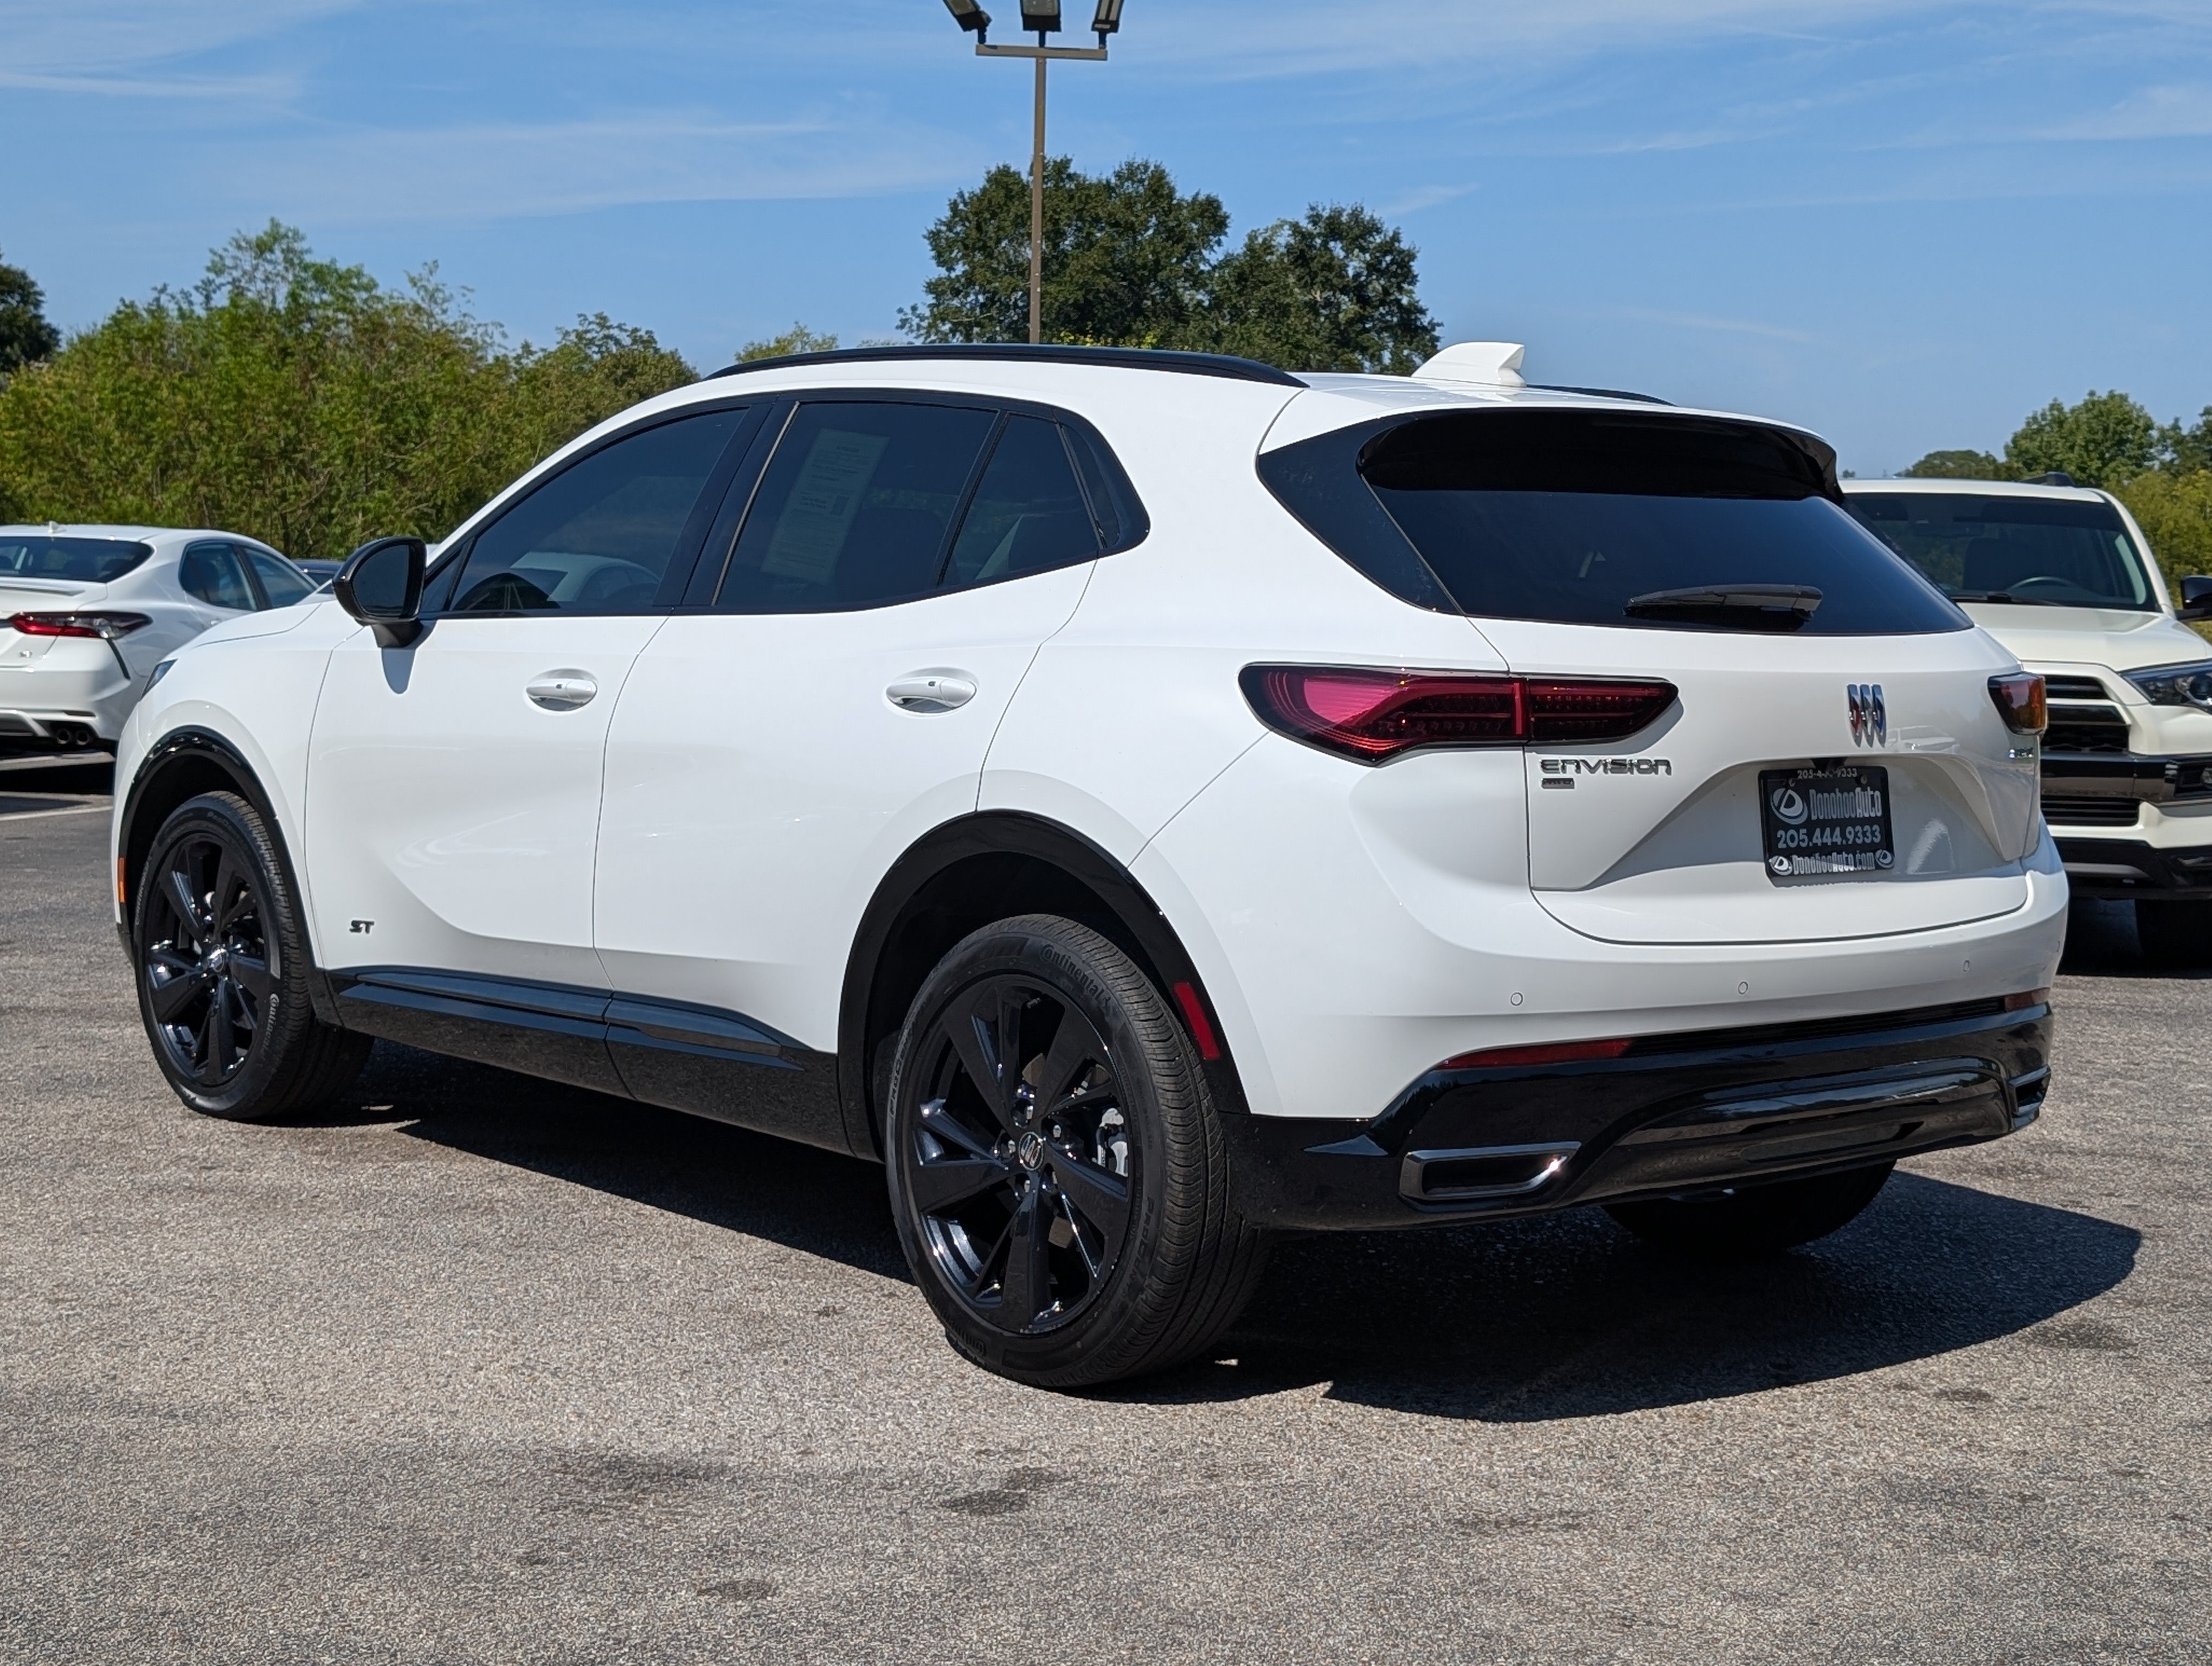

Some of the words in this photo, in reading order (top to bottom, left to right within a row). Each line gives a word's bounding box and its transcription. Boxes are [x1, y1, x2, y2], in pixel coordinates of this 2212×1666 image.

[1539, 758, 1672, 776] ENVISION
[1796, 767, 1858, 779] 205-49333
[1809, 786, 1883, 821] DonohooAuto
[1777, 824, 1881, 849] 205.444.9333
[1792, 850, 1876, 875] DonohooAuto.com
[349, 920, 375, 934] ST
[1039, 944, 1104, 1001] Continental
